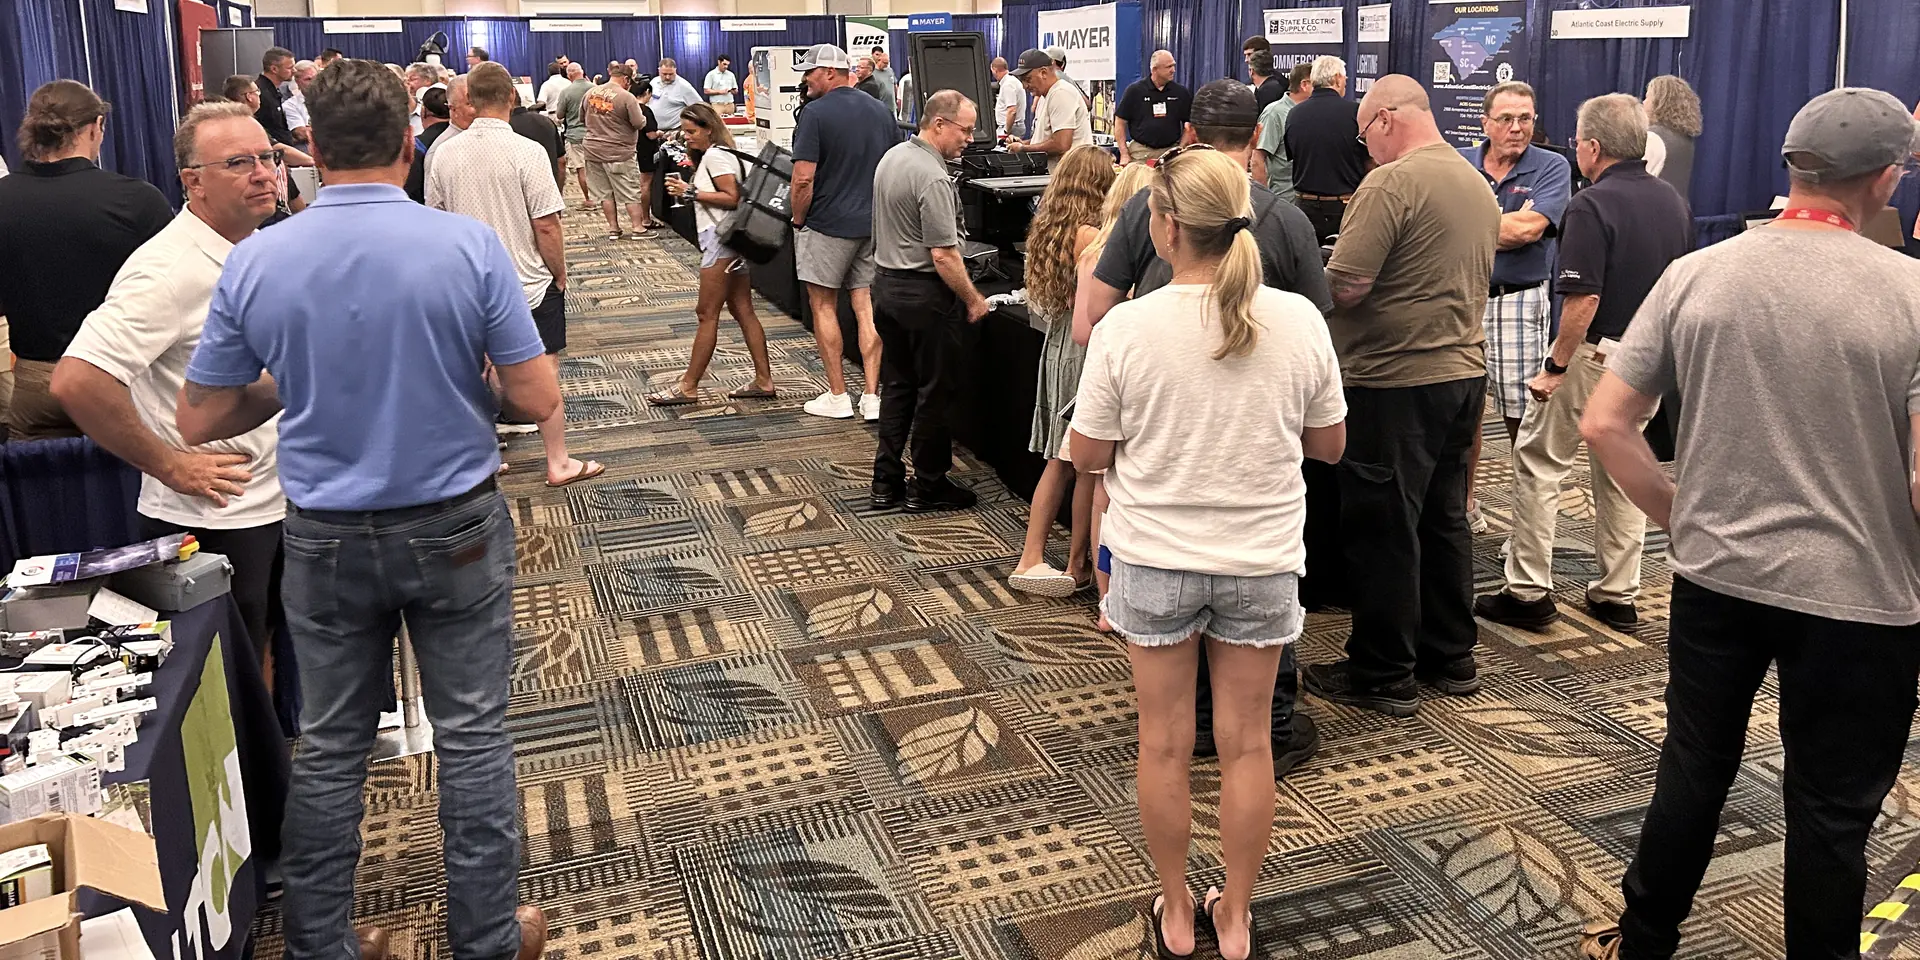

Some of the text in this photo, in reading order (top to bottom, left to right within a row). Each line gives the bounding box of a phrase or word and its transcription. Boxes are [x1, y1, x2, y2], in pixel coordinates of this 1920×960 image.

[1467, 5, 1499, 13] LOCATIONS
[1640, 19, 1663, 27] Supply
[853, 36, 884, 45] CCS
[1058, 26, 1110, 49] MAYER
[1485, 35, 1496, 45] NC
[1460, 58, 1470, 68] SC
